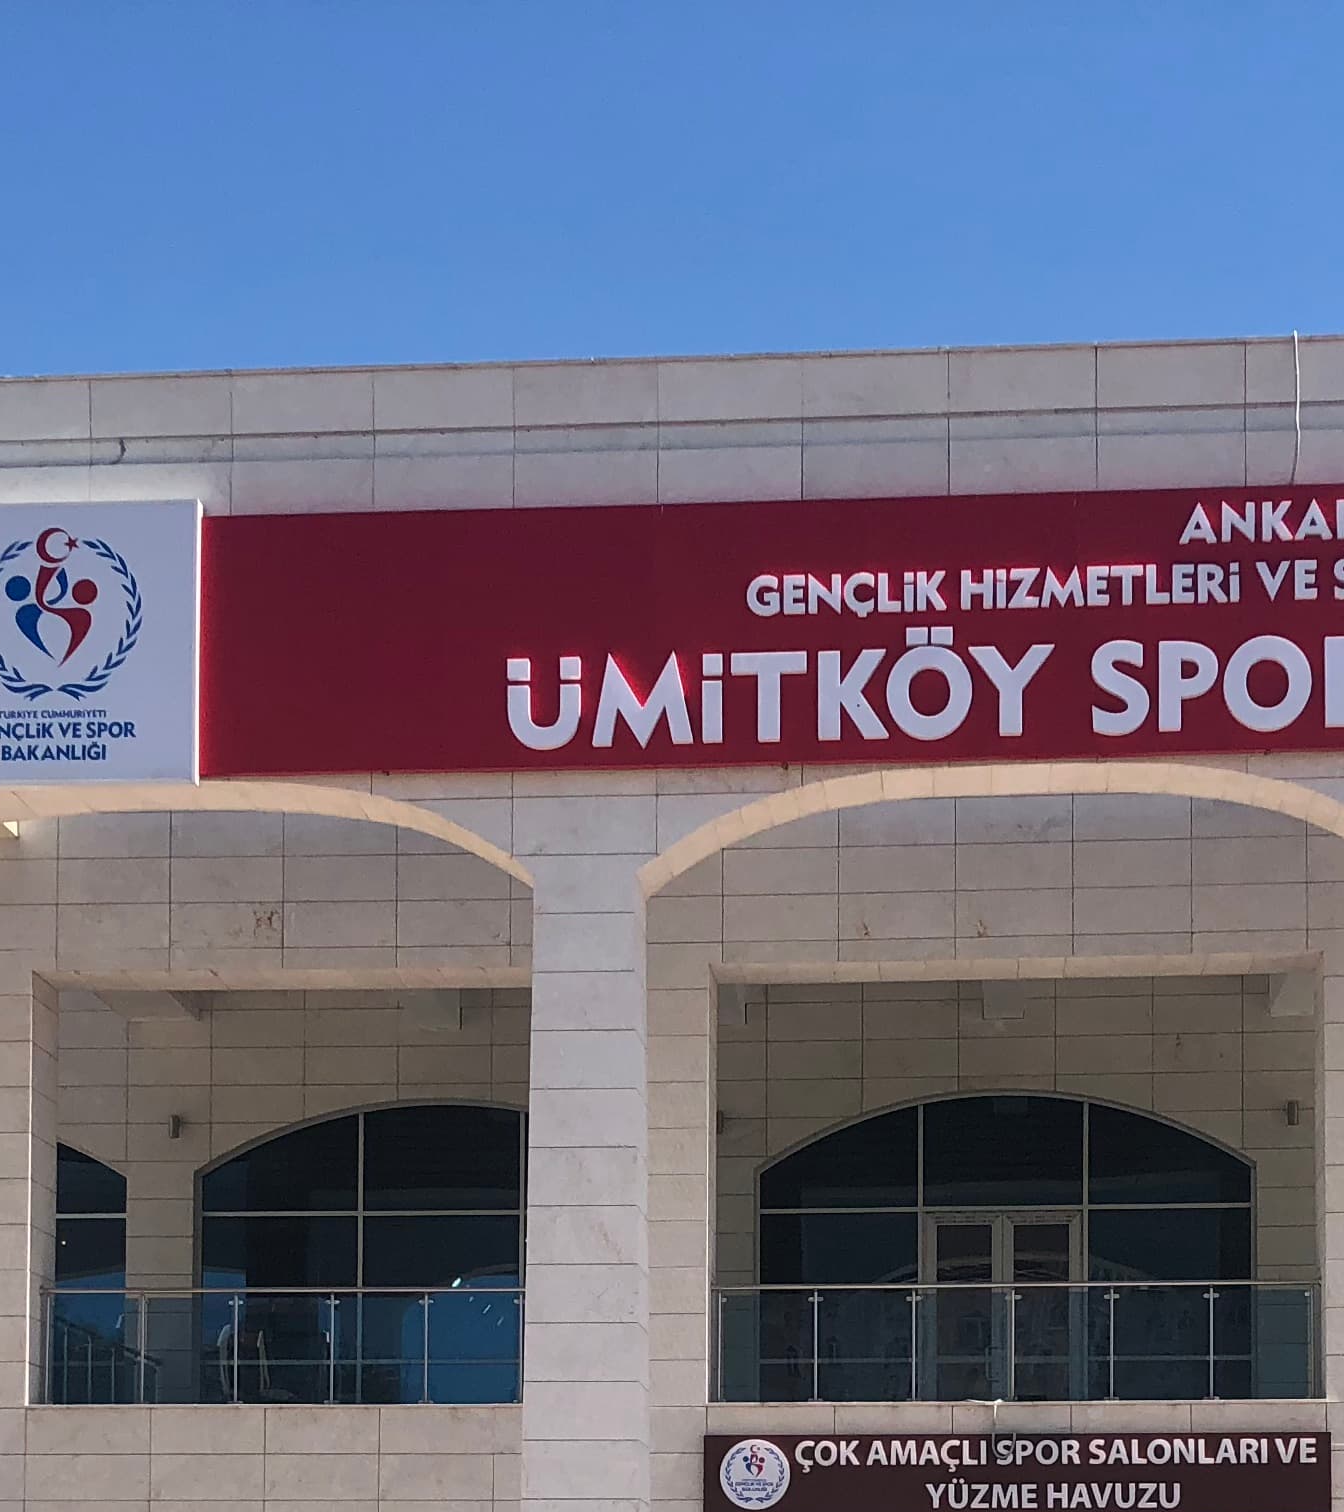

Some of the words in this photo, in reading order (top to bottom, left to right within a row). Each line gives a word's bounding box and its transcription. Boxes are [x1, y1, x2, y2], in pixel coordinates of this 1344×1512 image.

[745, 569, 947, 618] GENÇLİK
[960, 562, 1241, 611] HİZMETLERİ
[1258, 559, 1317, 602] VE
[505, 625, 1054, 750] ÜMİTKÖY
[57, 721, 83, 739] VE
[85, 720, 137, 739] SPOR
[0, 741, 107, 761] BAKANLIĞI
[793, 1439, 860, 1474] ÇOK
[865, 1438, 988, 1473] AMAÇLI
[995, 1438, 1081, 1466] SPOR
[1087, 1437, 1269, 1465] SALONLARI
[1273, 1436, 1318, 1464] VE
[925, 1477, 1038, 1510] YÜZME
[1046, 1481, 1182, 1510] HAVUZU
